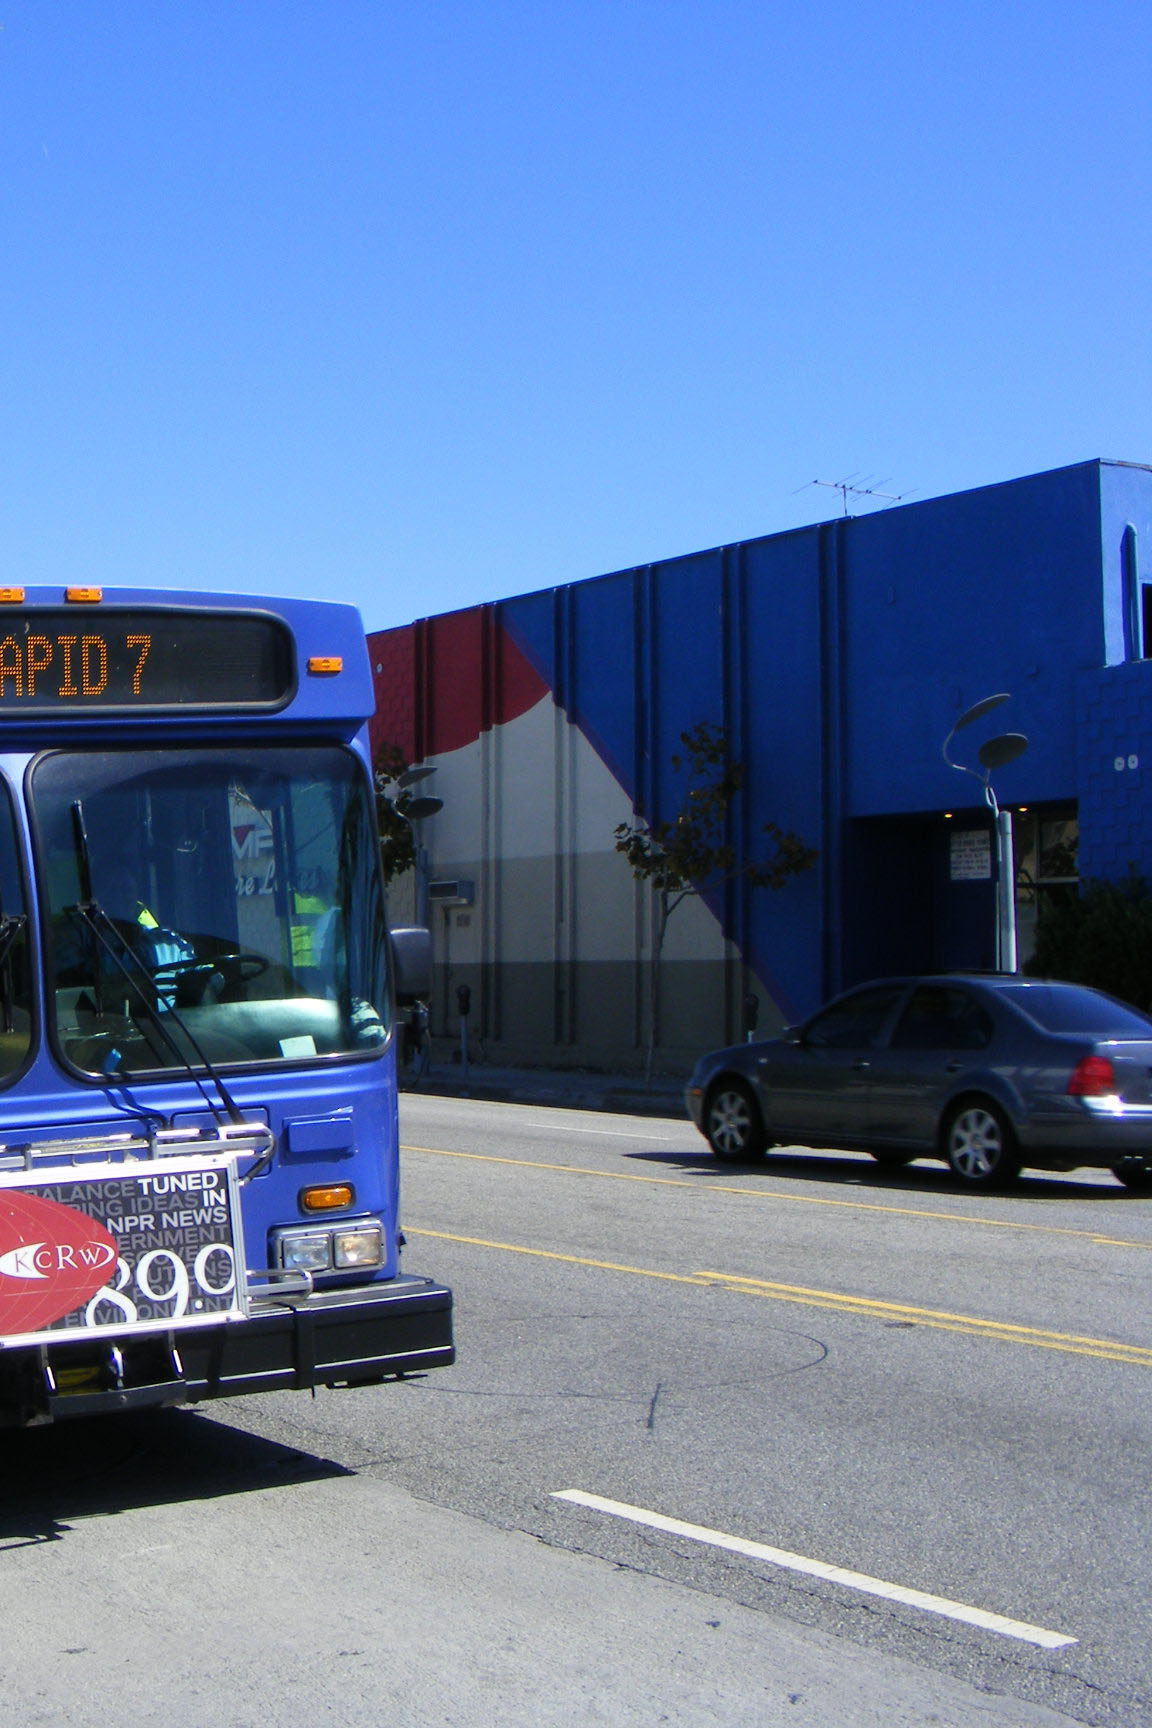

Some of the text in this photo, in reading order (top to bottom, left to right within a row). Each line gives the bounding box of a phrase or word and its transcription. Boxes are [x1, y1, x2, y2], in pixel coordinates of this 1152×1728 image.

[126, 634, 152, 696] 7
[137, 1172, 219, 1196] TUNED
[131, 1192, 198, 1213] IDEAS
[203, 1189, 226, 1207] IN
[106, 1206, 227, 1234] NPR NEWS
[14, 1244, 101, 1273] KCRW
